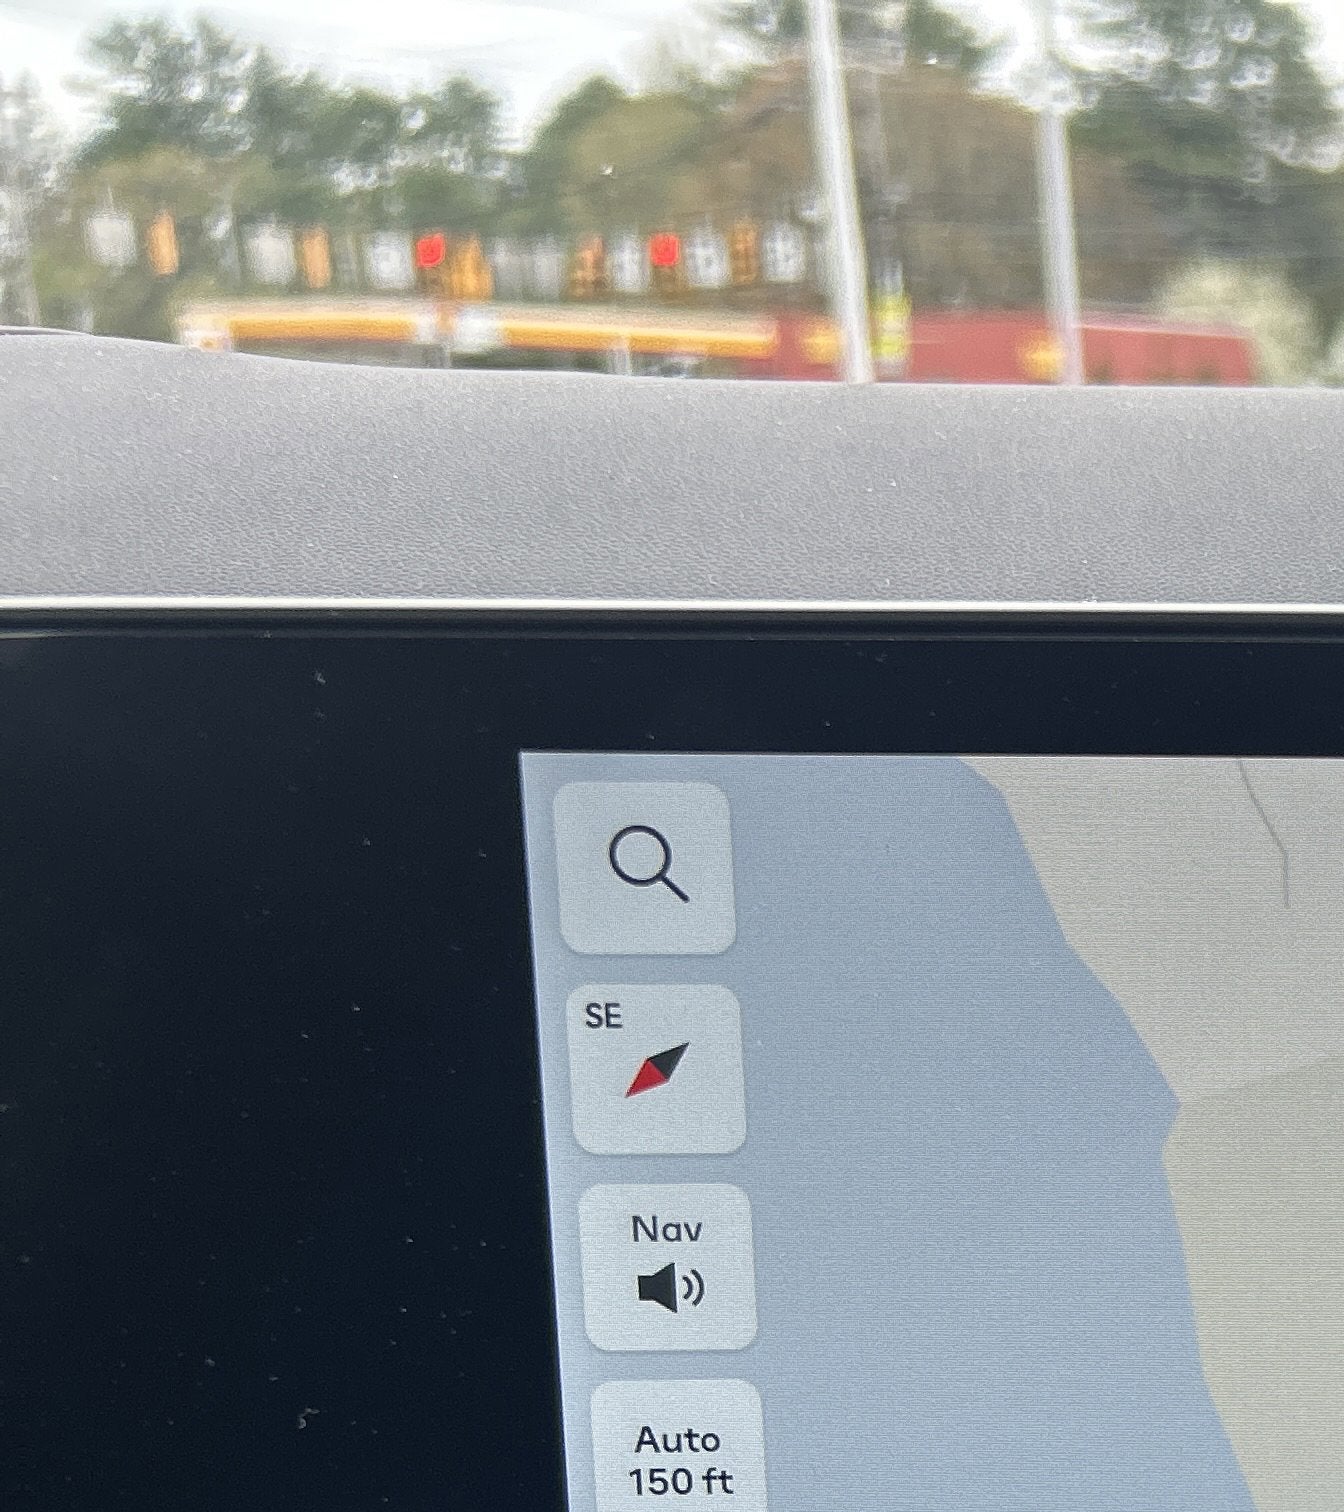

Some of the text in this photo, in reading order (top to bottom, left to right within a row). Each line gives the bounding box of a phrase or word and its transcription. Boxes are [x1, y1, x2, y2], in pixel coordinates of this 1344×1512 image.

[584, 1002, 624, 1029] SE
[631, 1215, 703, 1243] Nav
[634, 1425, 721, 1453] Auto
[628, 1466, 735, 1496] 150 ft
